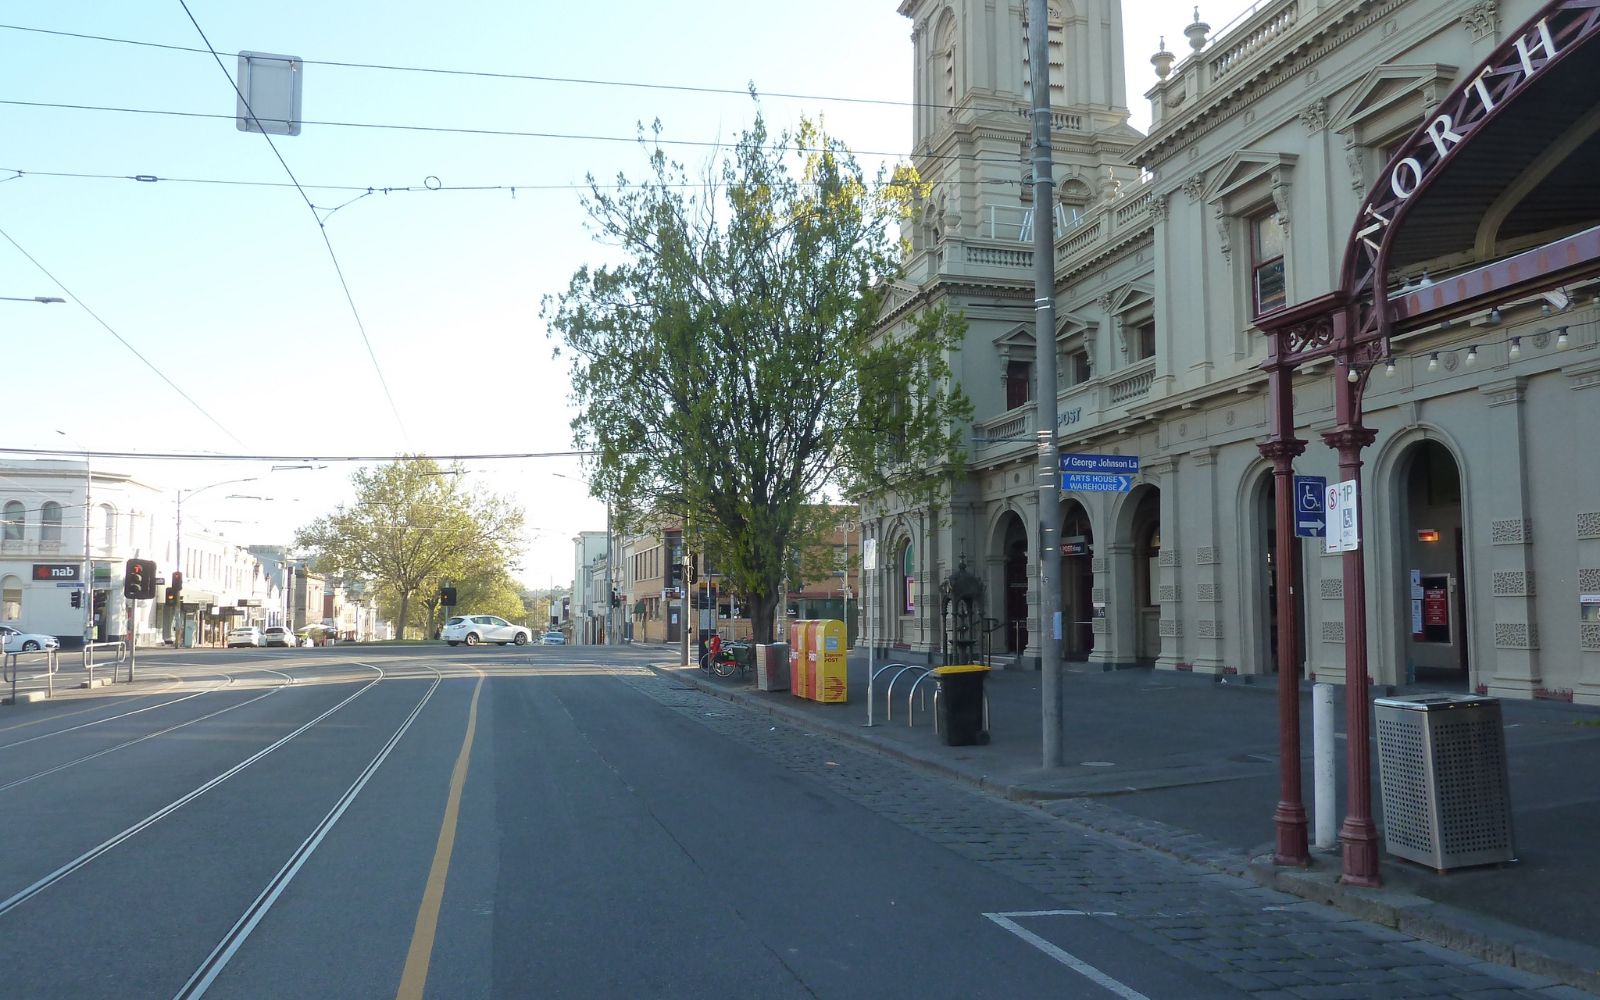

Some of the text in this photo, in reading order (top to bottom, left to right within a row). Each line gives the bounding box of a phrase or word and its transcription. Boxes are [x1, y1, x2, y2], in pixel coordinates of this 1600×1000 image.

[1355, 17, 1558, 252] NORTH
[1071, 457, 1138, 469] George Johnson La
[1070, 474, 1118, 483] ARTS HOUSE
[1069, 482, 1118, 491] WAREHOUSE
[1342, 484, 1353, 502] 1P
[52, 567, 74, 576] nab
